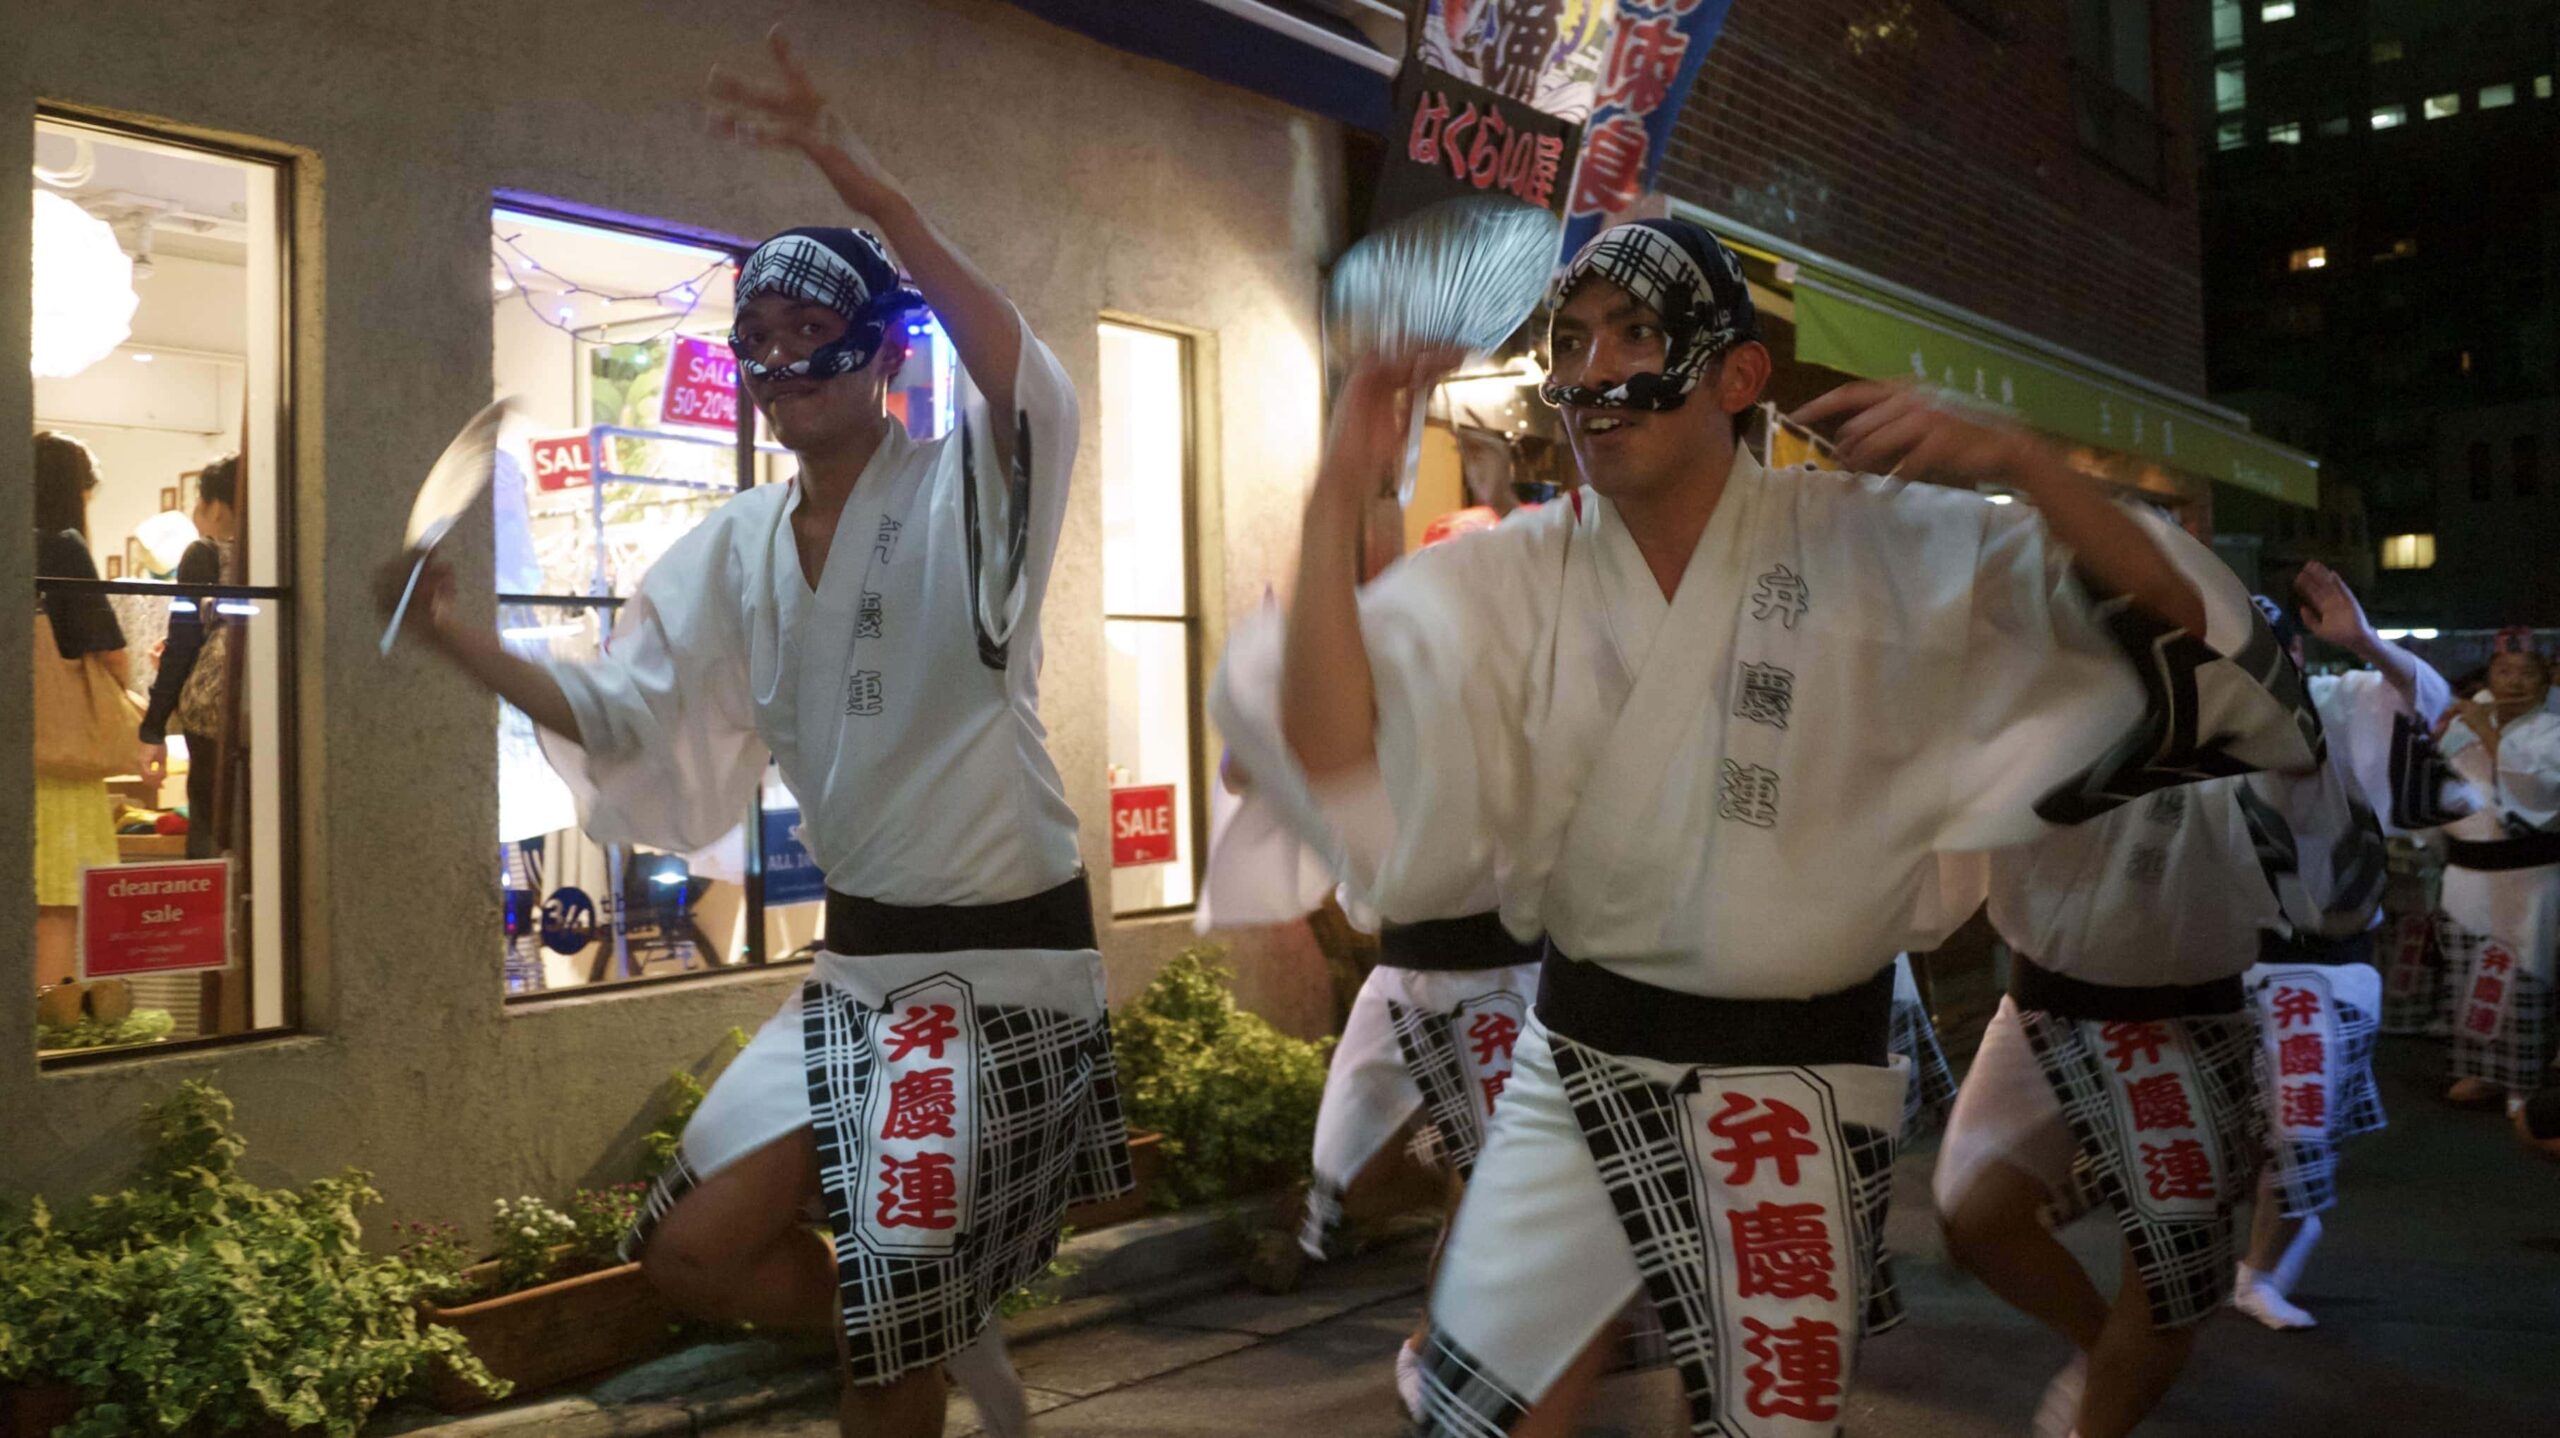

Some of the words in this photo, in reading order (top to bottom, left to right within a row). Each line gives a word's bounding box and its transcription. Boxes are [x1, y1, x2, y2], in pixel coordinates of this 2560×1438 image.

[535, 444, 606, 476] SAL
[1719, 563, 1808, 828] 弁慶連
[107, 878, 212, 897] clearance
[1116, 806, 1169, 839] SALE
[141, 904, 184, 924] sale
[876, 1004, 959, 1229] 弁慶連
[2102, 1021, 2216, 1201] 弁慶連
[2272, 986, 2325, 1127] 弁慶連
[1708, 1091, 1841, 1422] 弁慶連
